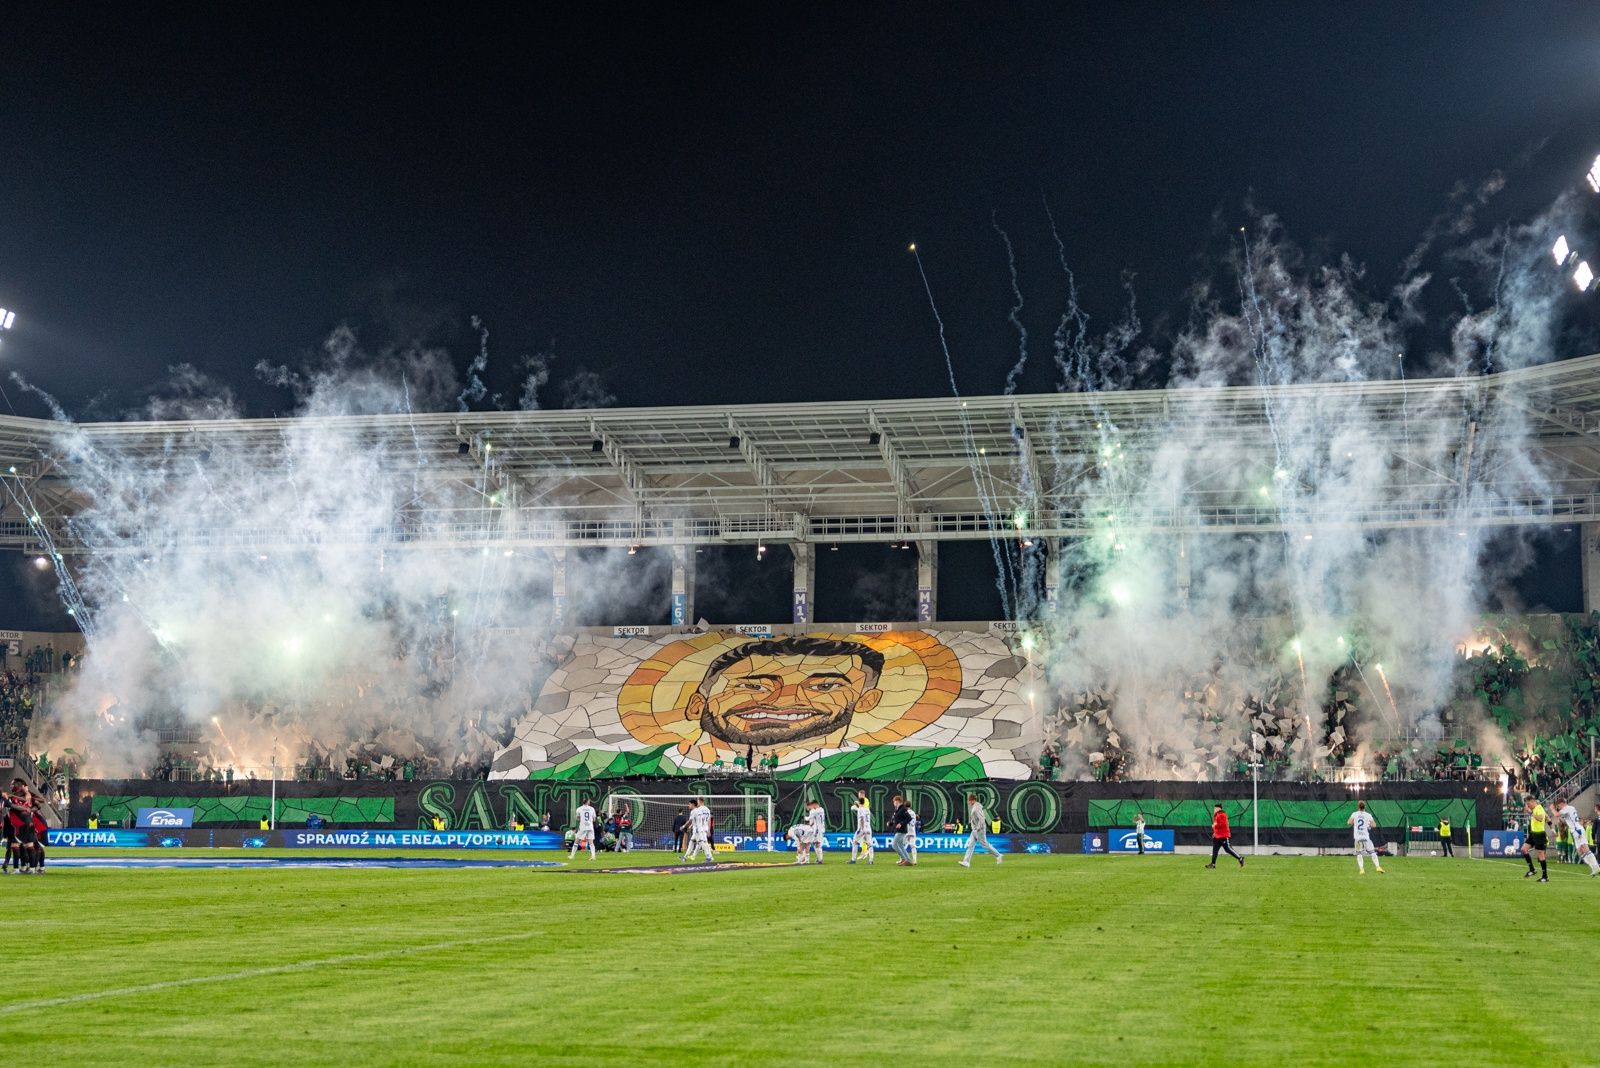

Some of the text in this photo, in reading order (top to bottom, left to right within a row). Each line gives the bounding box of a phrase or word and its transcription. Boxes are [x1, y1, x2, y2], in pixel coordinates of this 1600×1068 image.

[674, 595, 682, 617] L6
[795, 593, 806, 616] M1
[919, 591, 930, 615] M2
[859, 623, 888, 631] SEKTOR
[418, 780, 1062, 833] SANTO LEANDRO
[151, 816, 183, 825] Enea
[584, 811, 590, 821] 9
[1358, 819, 1364, 830] 2
[297, 832, 531, 847] SPRAWDŹ NA ENEA.PL/OPTIMA
